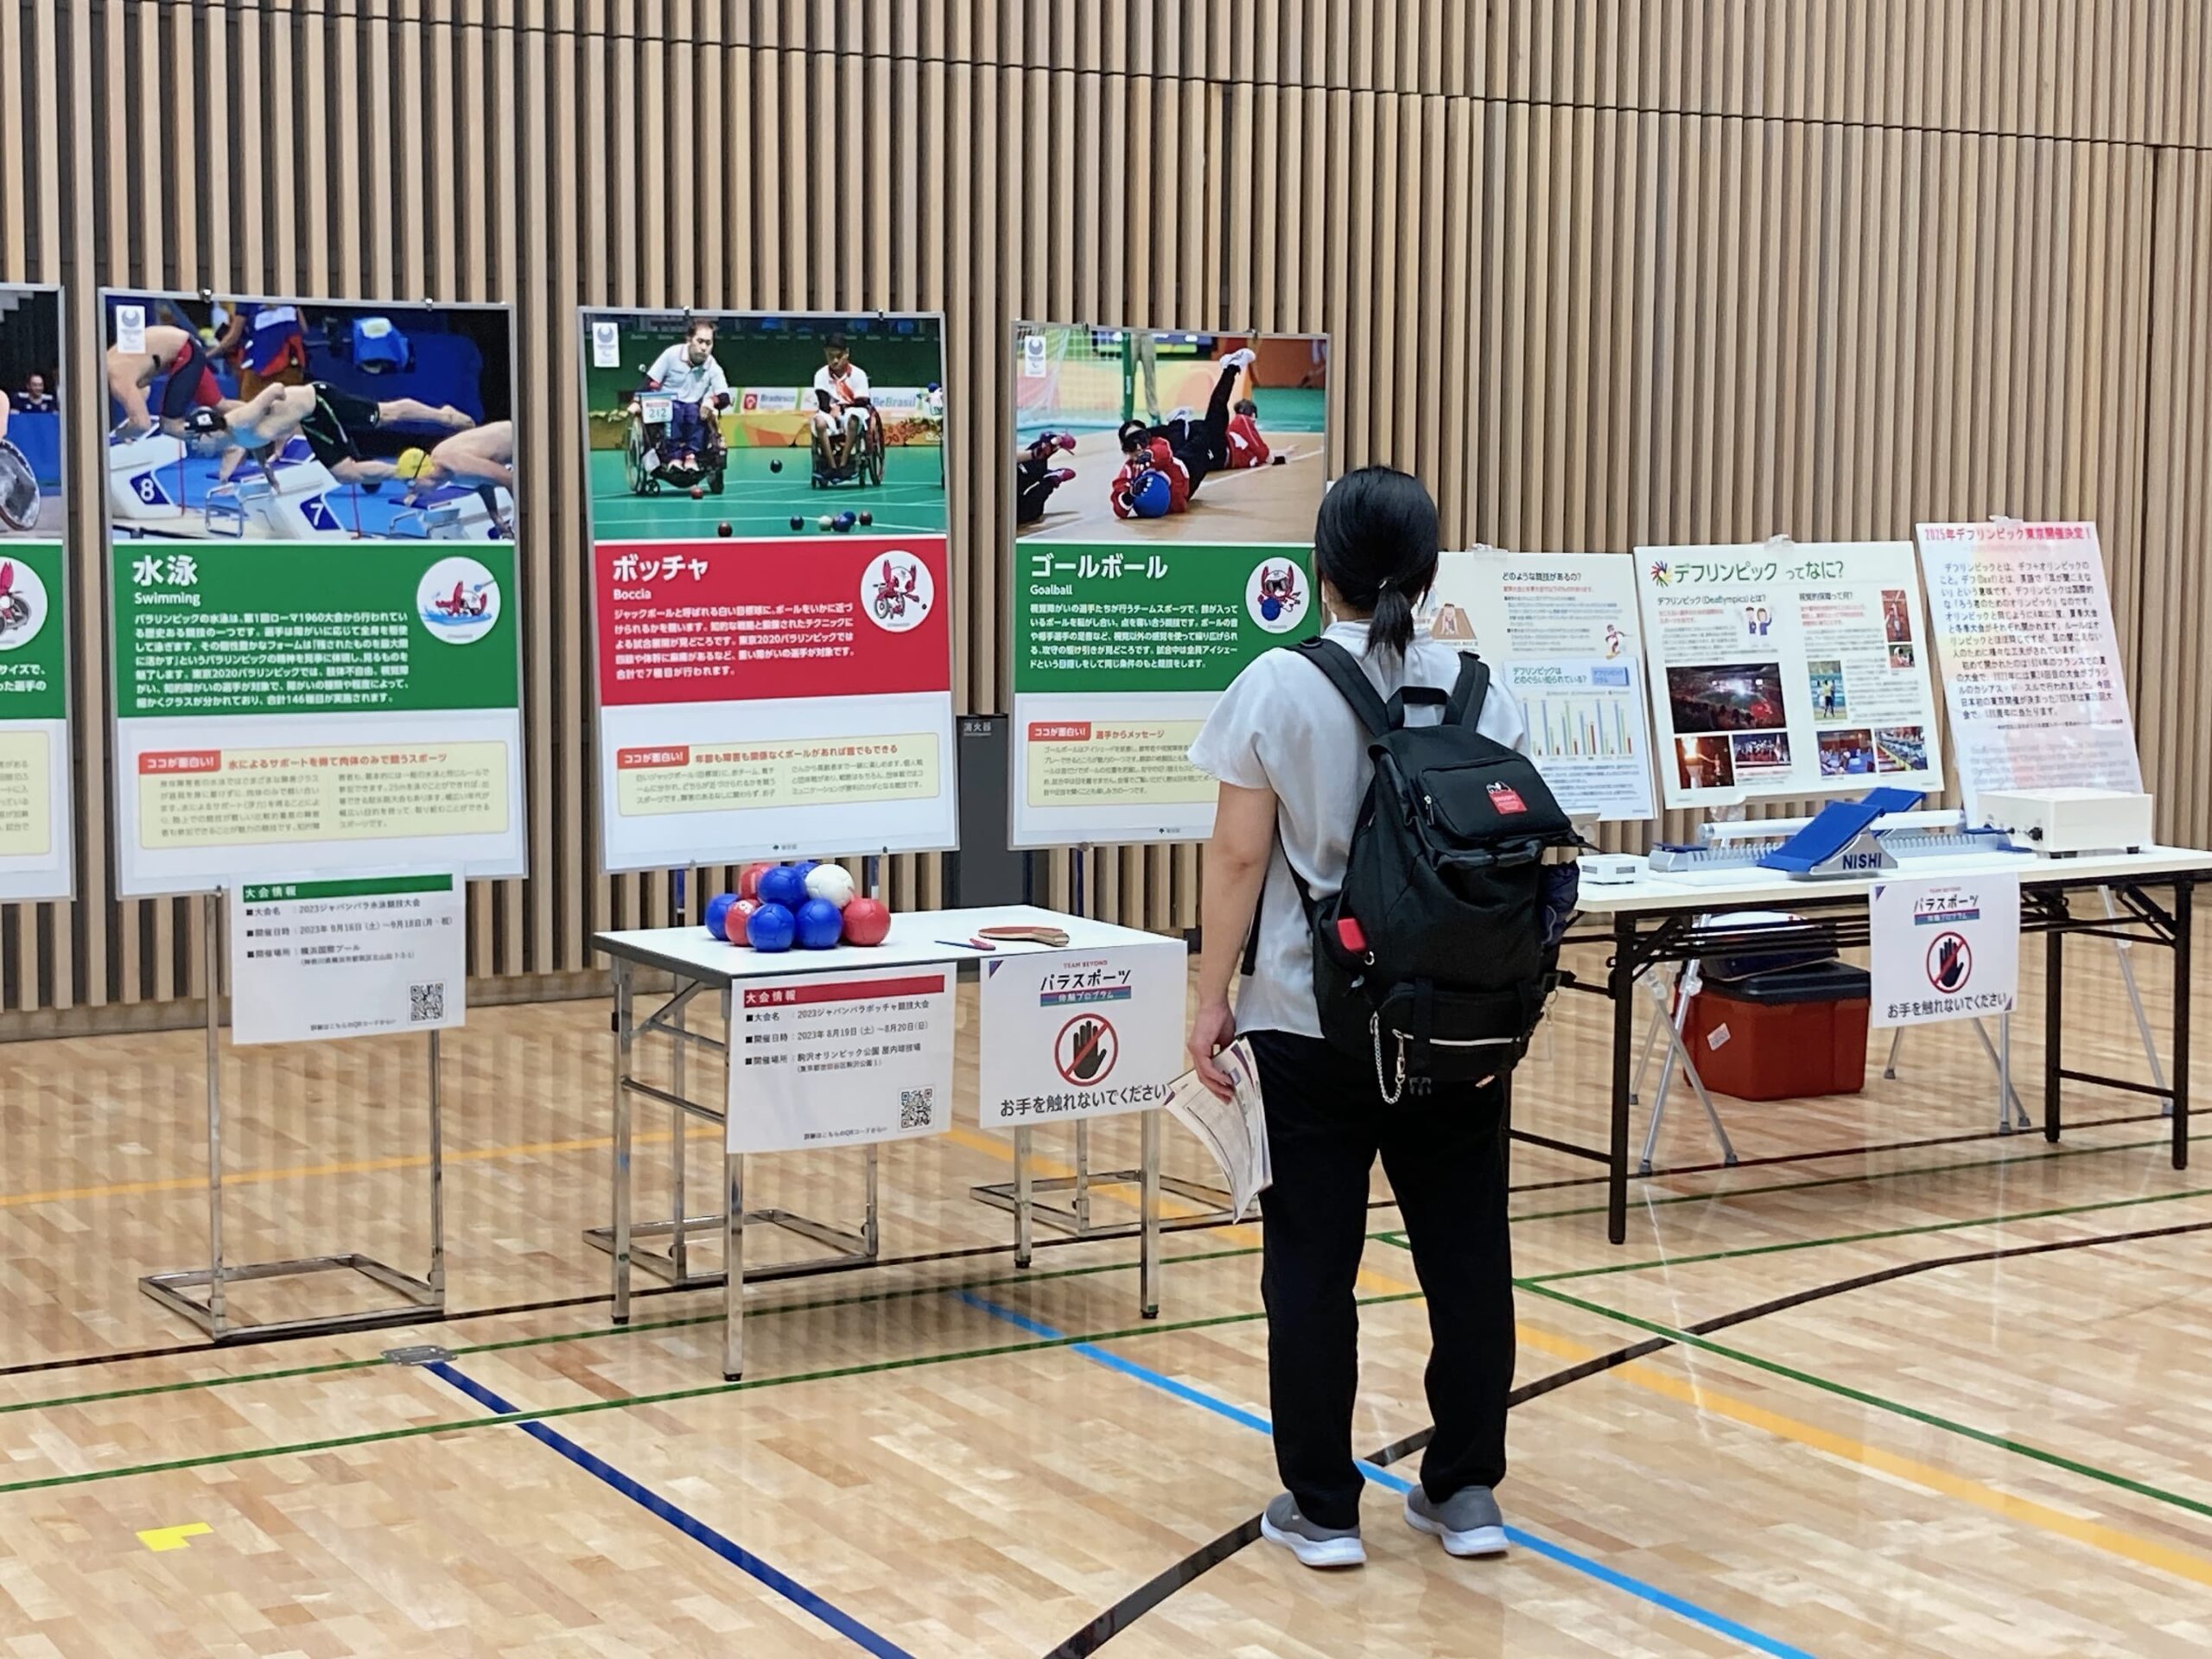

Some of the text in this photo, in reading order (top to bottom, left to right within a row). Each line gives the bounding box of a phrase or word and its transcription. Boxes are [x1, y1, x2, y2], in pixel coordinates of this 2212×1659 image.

[649, 408, 666, 418] 212
[140, 480, 154, 501] 8
[311, 502, 324, 526] 7
[132, 555, 198, 587] 水泳
[612, 554, 709, 582] ボッチャ
[1031, 553, 1168, 579] ゴールボール
[1675, 563, 1777, 582] デフリンピック
[613, 589, 652, 601] Boccia
[1030, 584, 1072, 595] Goalball
[135, 592, 200, 607] Swimming
[963, 722, 991, 732] 消火器
[1096, 730, 1165, 740] 選手からメッセージ
[1842, 853, 1882, 869] NISHI
[245, 885, 297, 899] 大会情報
[1914, 894, 1979, 912] パラスポーツ
[1082, 959, 1108, 968] BEYOND
[1040, 969, 1131, 991] パラスポーツ
[746, 989, 796, 1004] 大会情報
[1888, 993, 2006, 1019] お手を触れないでください
[1001, 1084, 1166, 1117] お手を触れないでください
